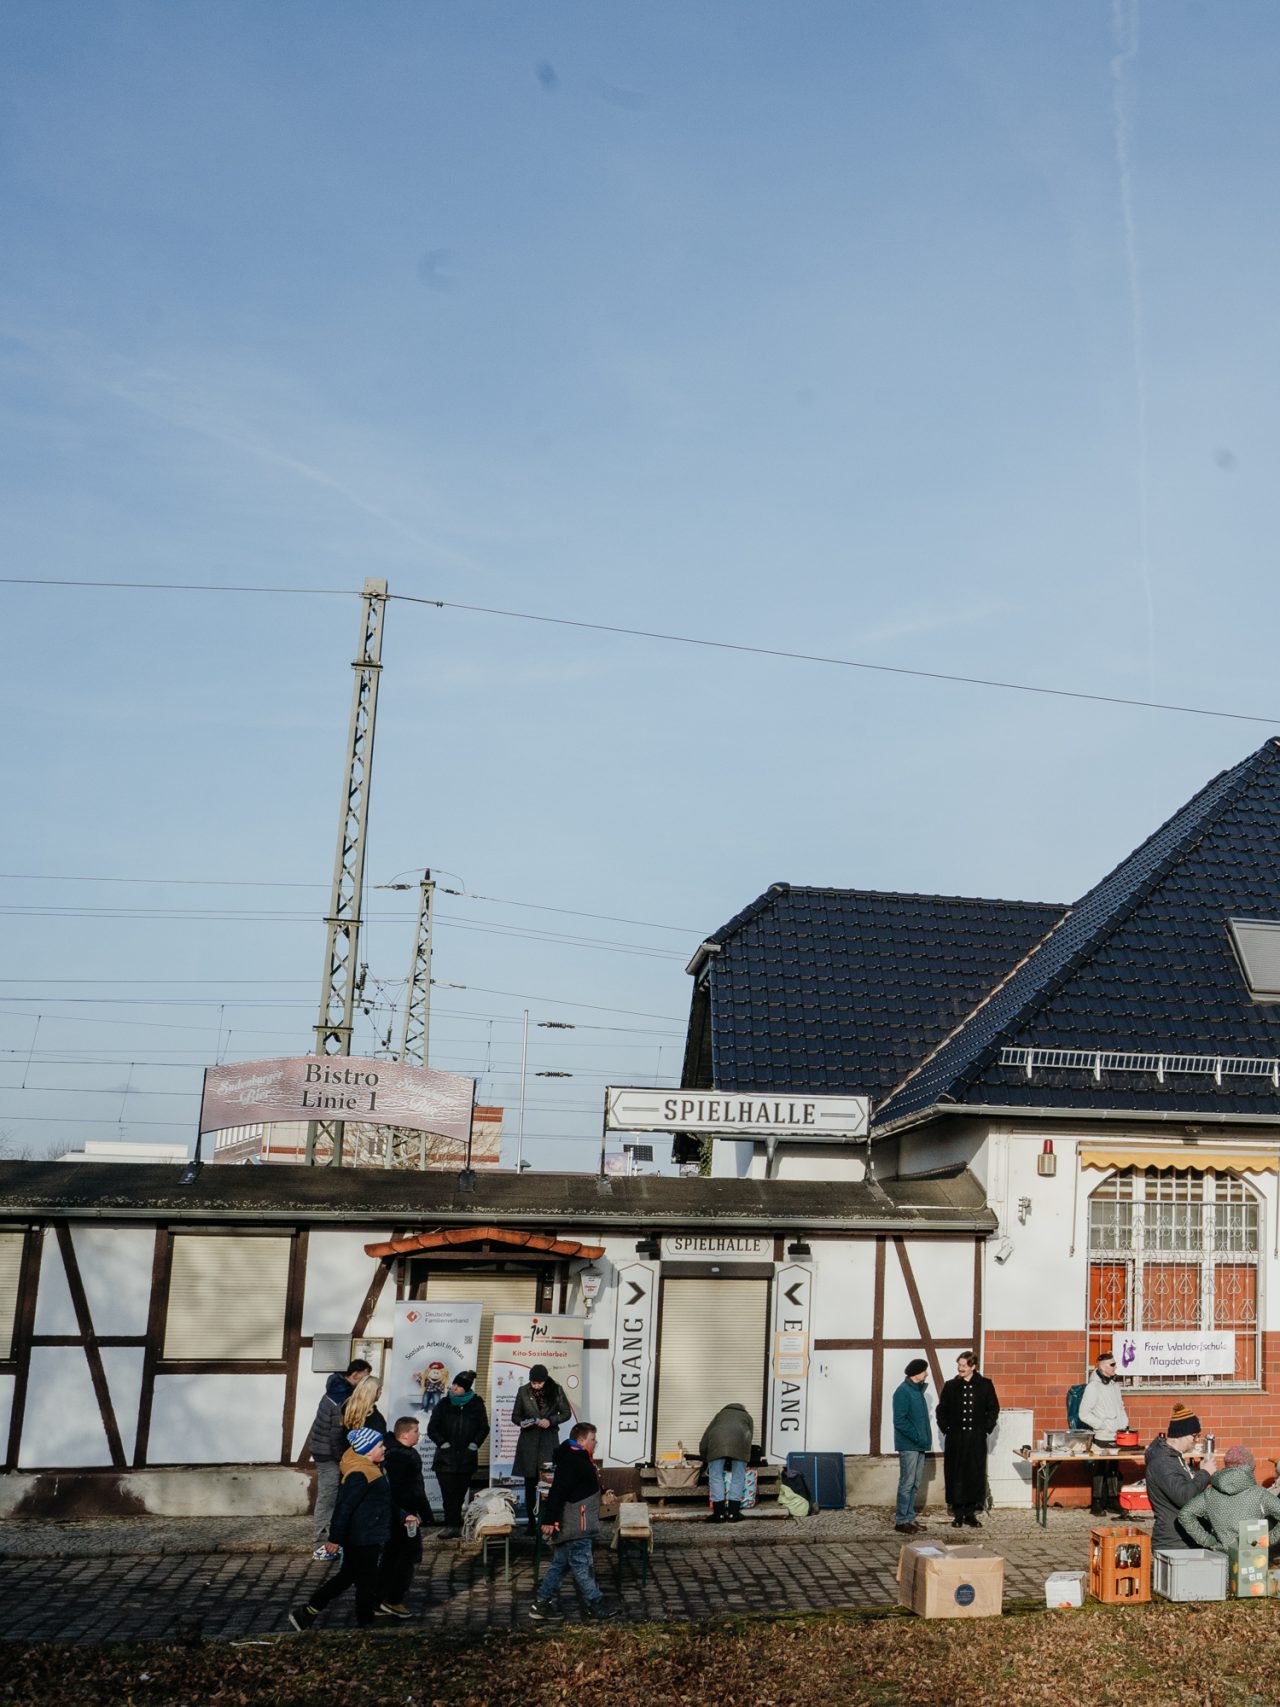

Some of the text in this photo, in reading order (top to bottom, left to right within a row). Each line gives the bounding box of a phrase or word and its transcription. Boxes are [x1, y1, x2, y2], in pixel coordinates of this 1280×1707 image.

[305, 1063, 379, 1087] Bistro
[302, 1090, 377, 1111] Linie 1
[664, 1099, 816, 1125] SPIELHALLE
[674, 1237, 761, 1252] SPIELHALLE
[426, 1340, 446, 1349] Arbeit
[1144, 1341, 1164, 1352] Freie
[512, 1350, 568, 1358] Kita-Sozialarbeit
[1149, 1356, 1201, 1368] Magdeburg
[618, 1318, 644, 1434] EINGANG
[780, 1319, 803, 1432] EANG
